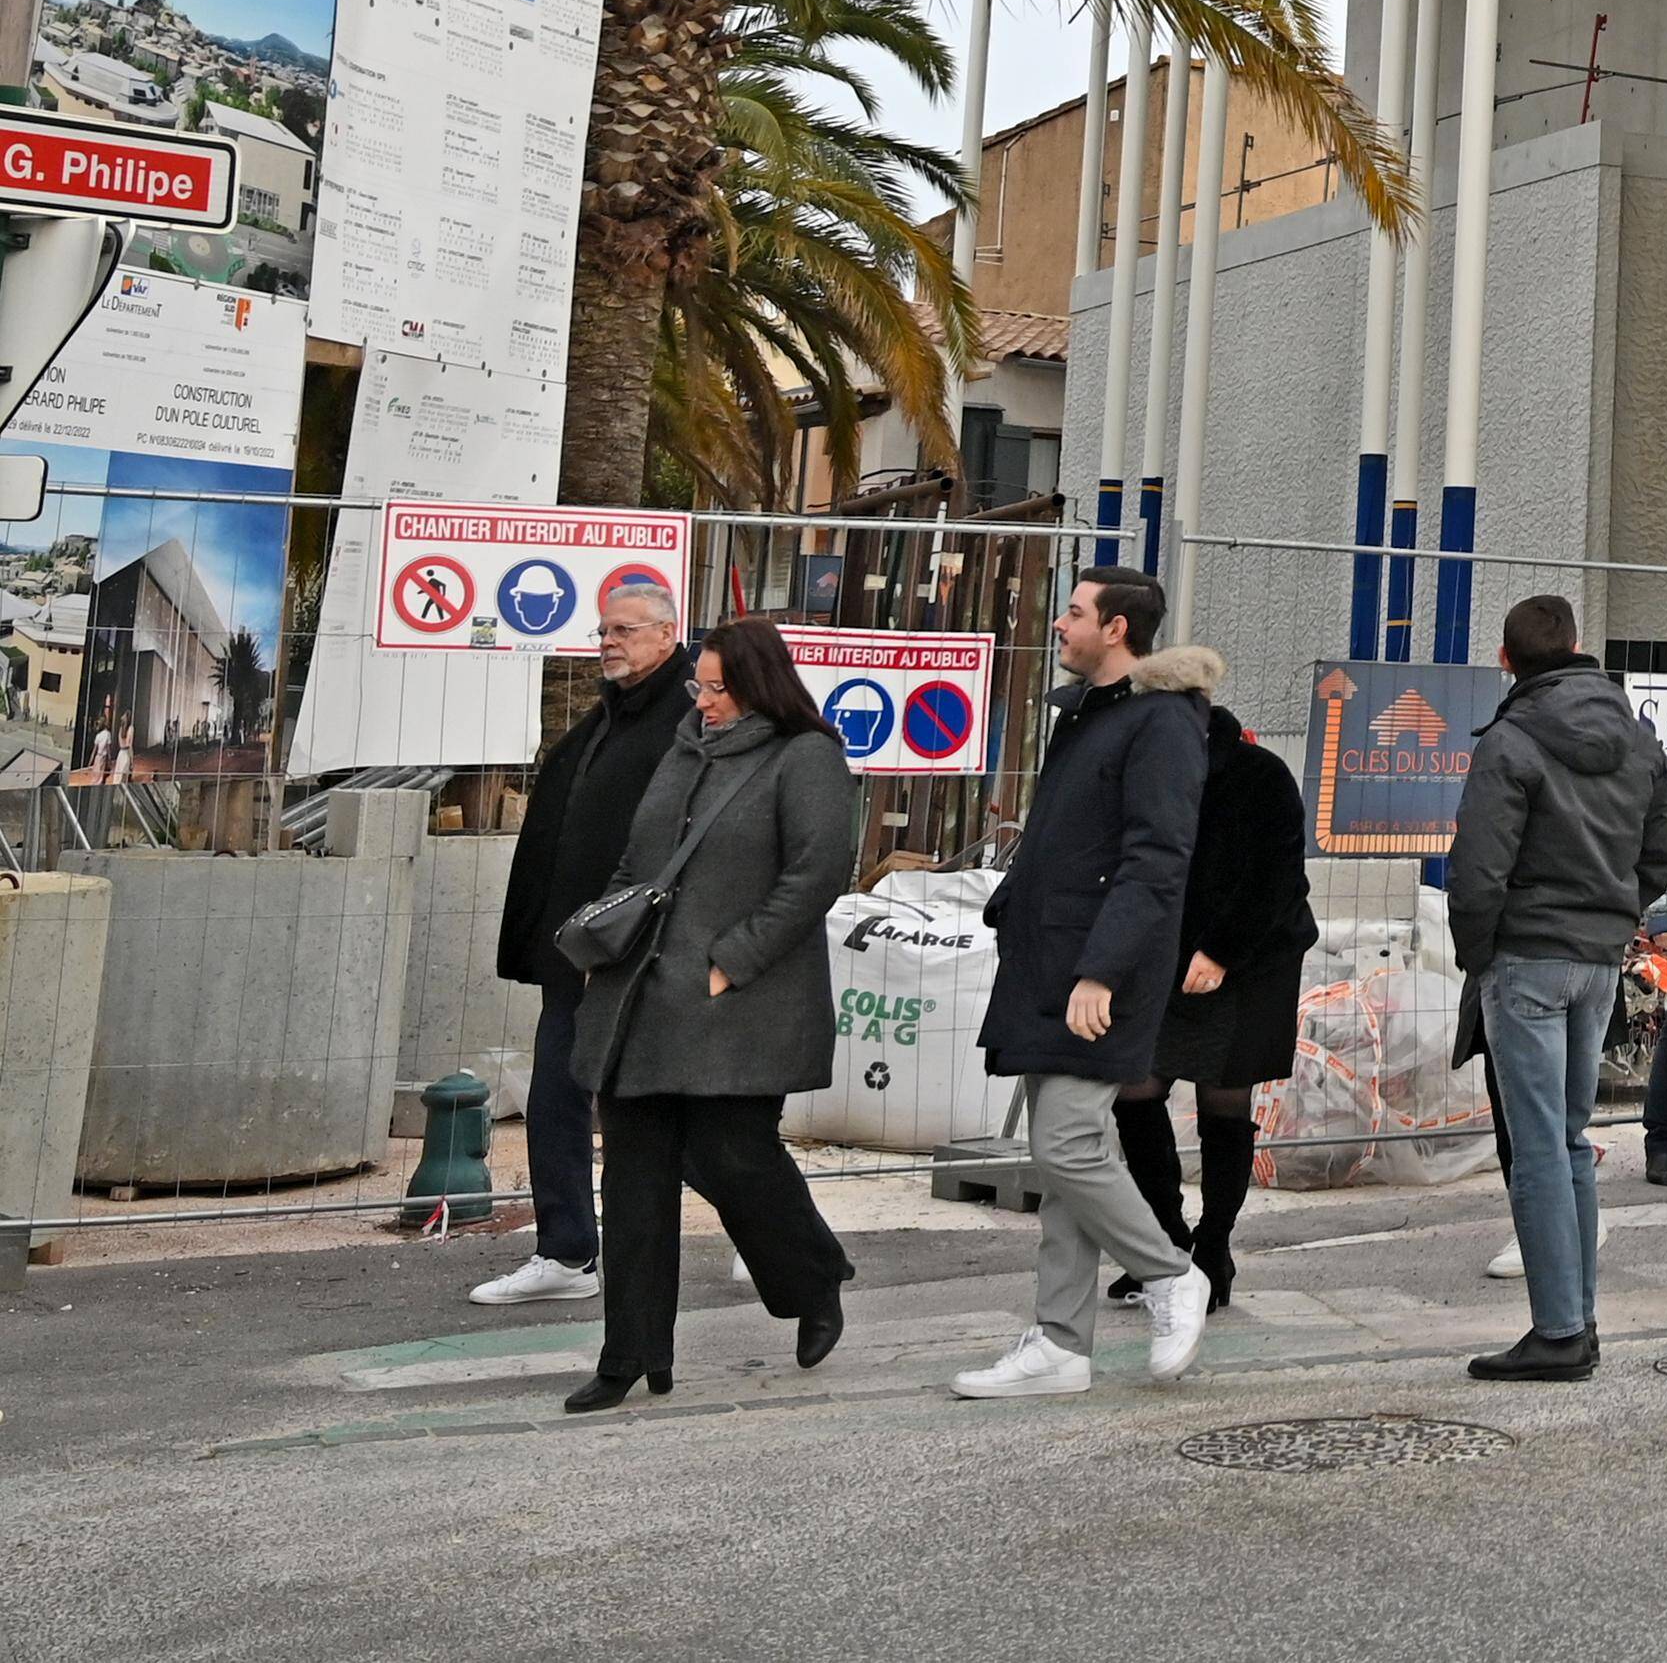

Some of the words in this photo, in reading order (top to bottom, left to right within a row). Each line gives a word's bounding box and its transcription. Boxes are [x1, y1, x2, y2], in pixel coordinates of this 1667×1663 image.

[4, 143, 45, 181] G.
[62, 150, 194, 203] Philipe
[24, 389, 64, 410] ERARD
[67, 394, 107, 415] PHILIPE
[173, 383, 253, 409] CONSTRUCTION
[155, 405, 179, 424] D'UN
[182, 409, 209, 428] POLE
[212, 412, 261, 435] CULTUREL
[400, 516, 491, 541] CHANTIER
[496, 519, 577, 544] INTERDIT
[582, 523, 606, 546] AU
[612, 525, 674, 548] PUBLIC
[792, 647, 825, 662] TIER
[829, 648, 897, 666] INTERDIT
[921, 652, 976, 668] PUBLIC
[1342, 750, 1390, 774] CLES
[1396, 751, 1425, 774] DU
[1430, 751, 1471, 774] SUD
